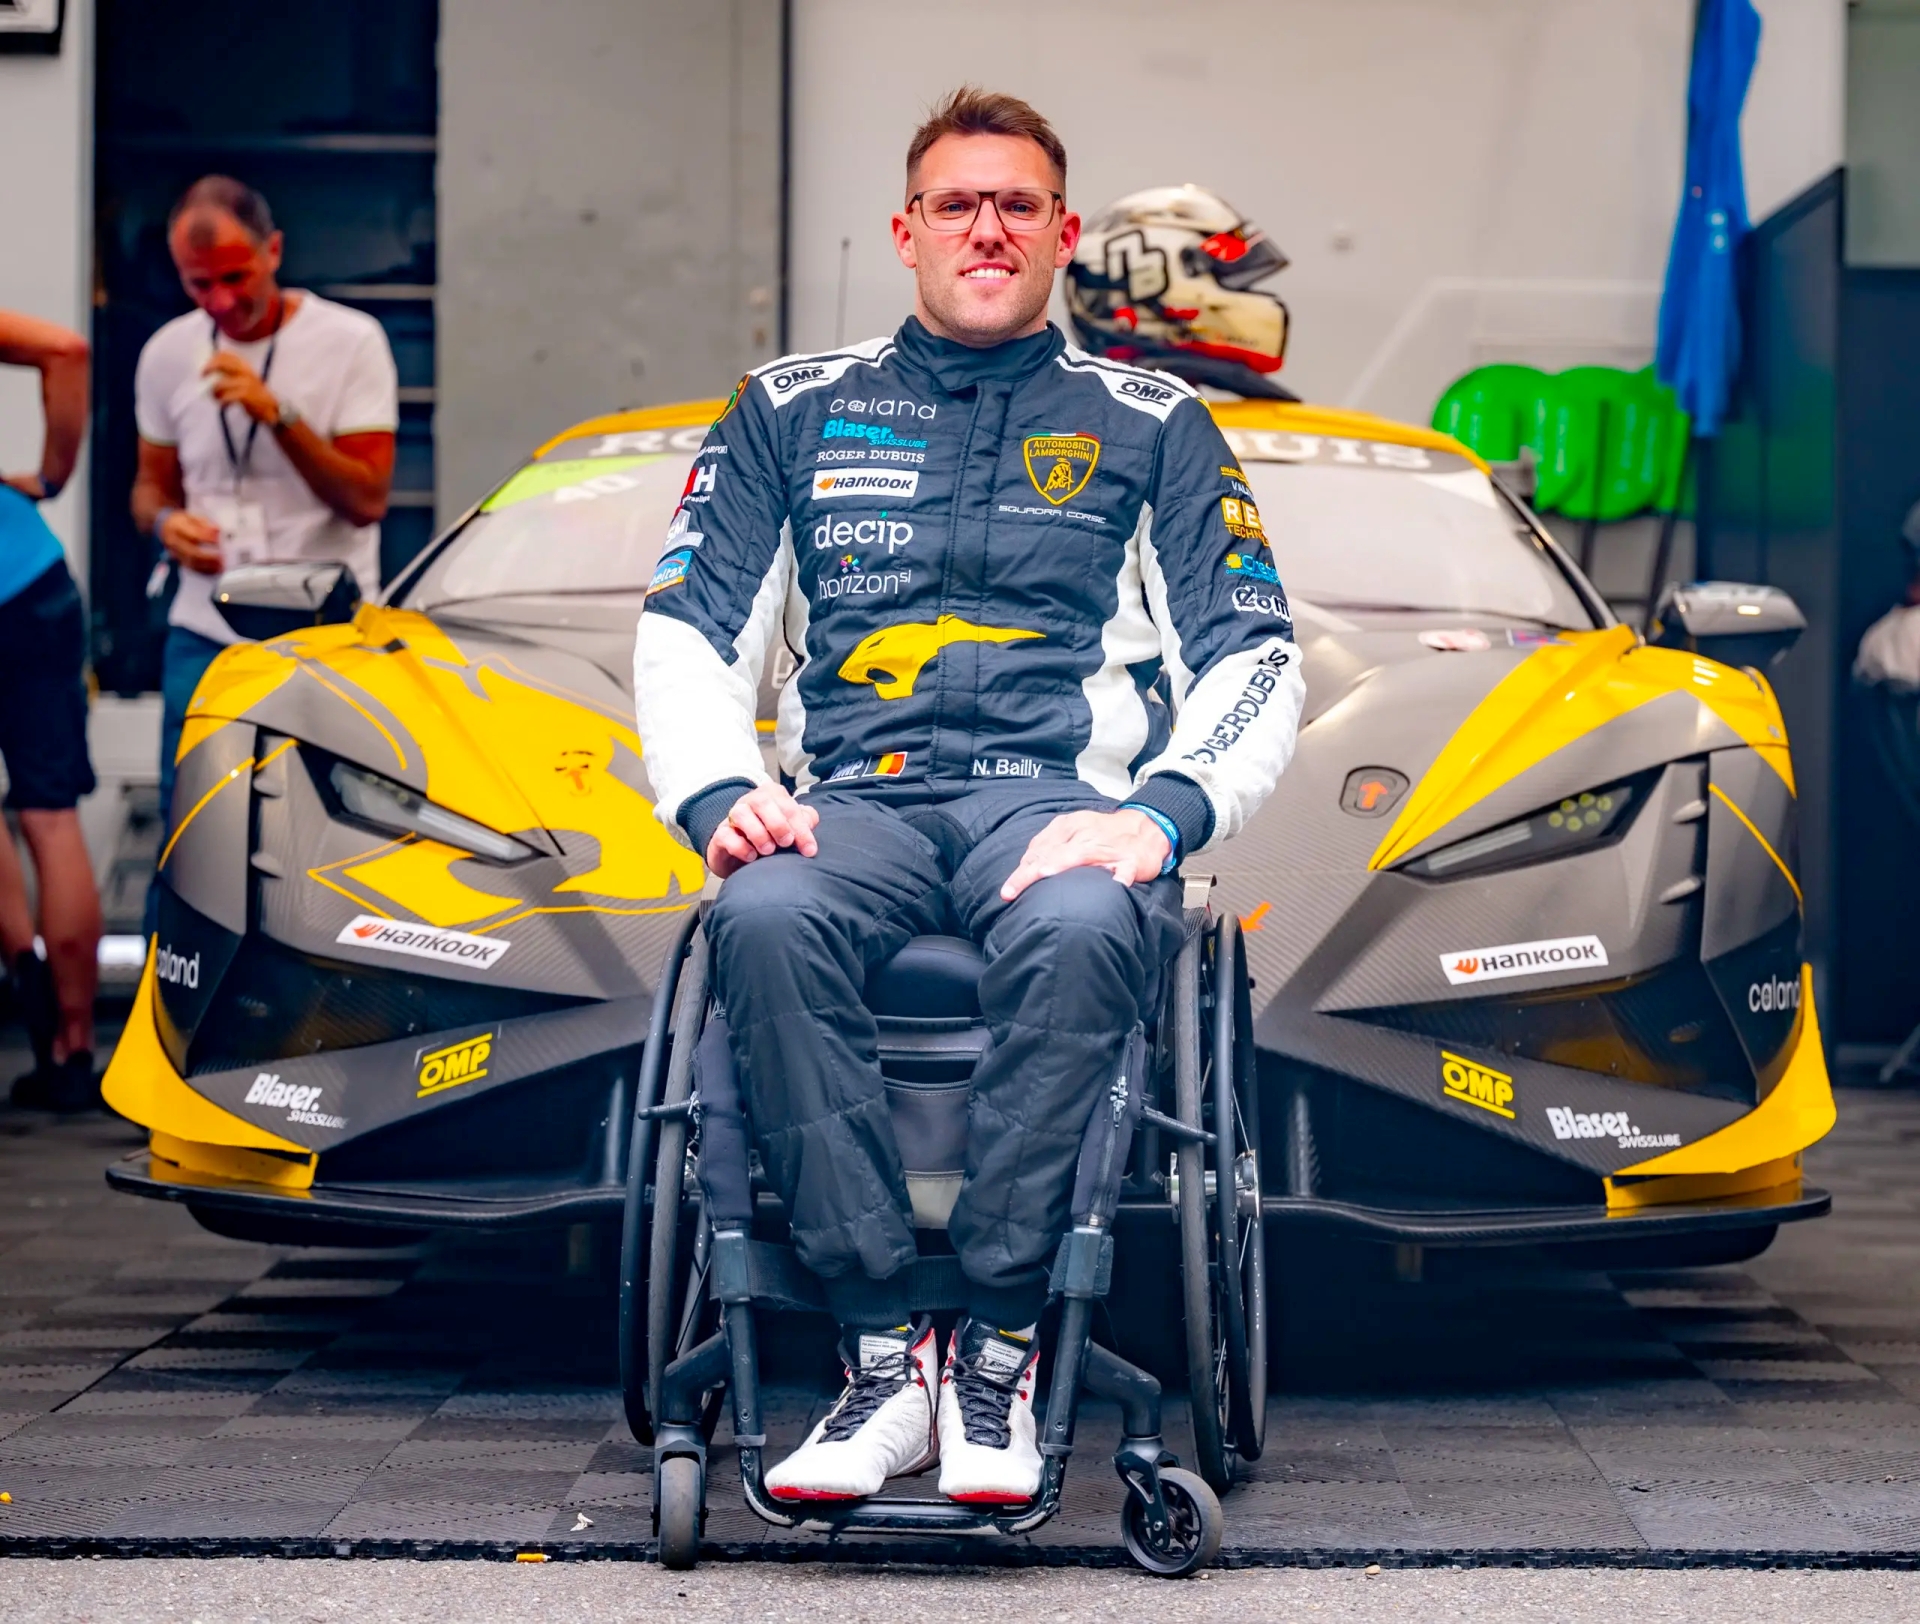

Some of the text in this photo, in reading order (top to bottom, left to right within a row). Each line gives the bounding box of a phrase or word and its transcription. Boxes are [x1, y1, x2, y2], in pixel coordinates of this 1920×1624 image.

[774, 368, 825, 389] OMP
[1121, 380, 1173, 402] OMP
[830, 398, 937, 419] caland
[1029, 449, 1092, 462] LAMBORGHINI
[1033, 441, 1090, 451] AUTOMOBILI
[816, 450, 925, 463] ROGER DUBUIS
[999, 505, 1106, 524] SQUADRA CORSE
[814, 512, 913, 553] decip
[972, 759, 1042, 779] N. Bailly
[419, 1042, 491, 1088] OMP
[1442, 1060, 1514, 1108] OMP
[1618, 1133, 1681, 1149] SWISSLUBE
